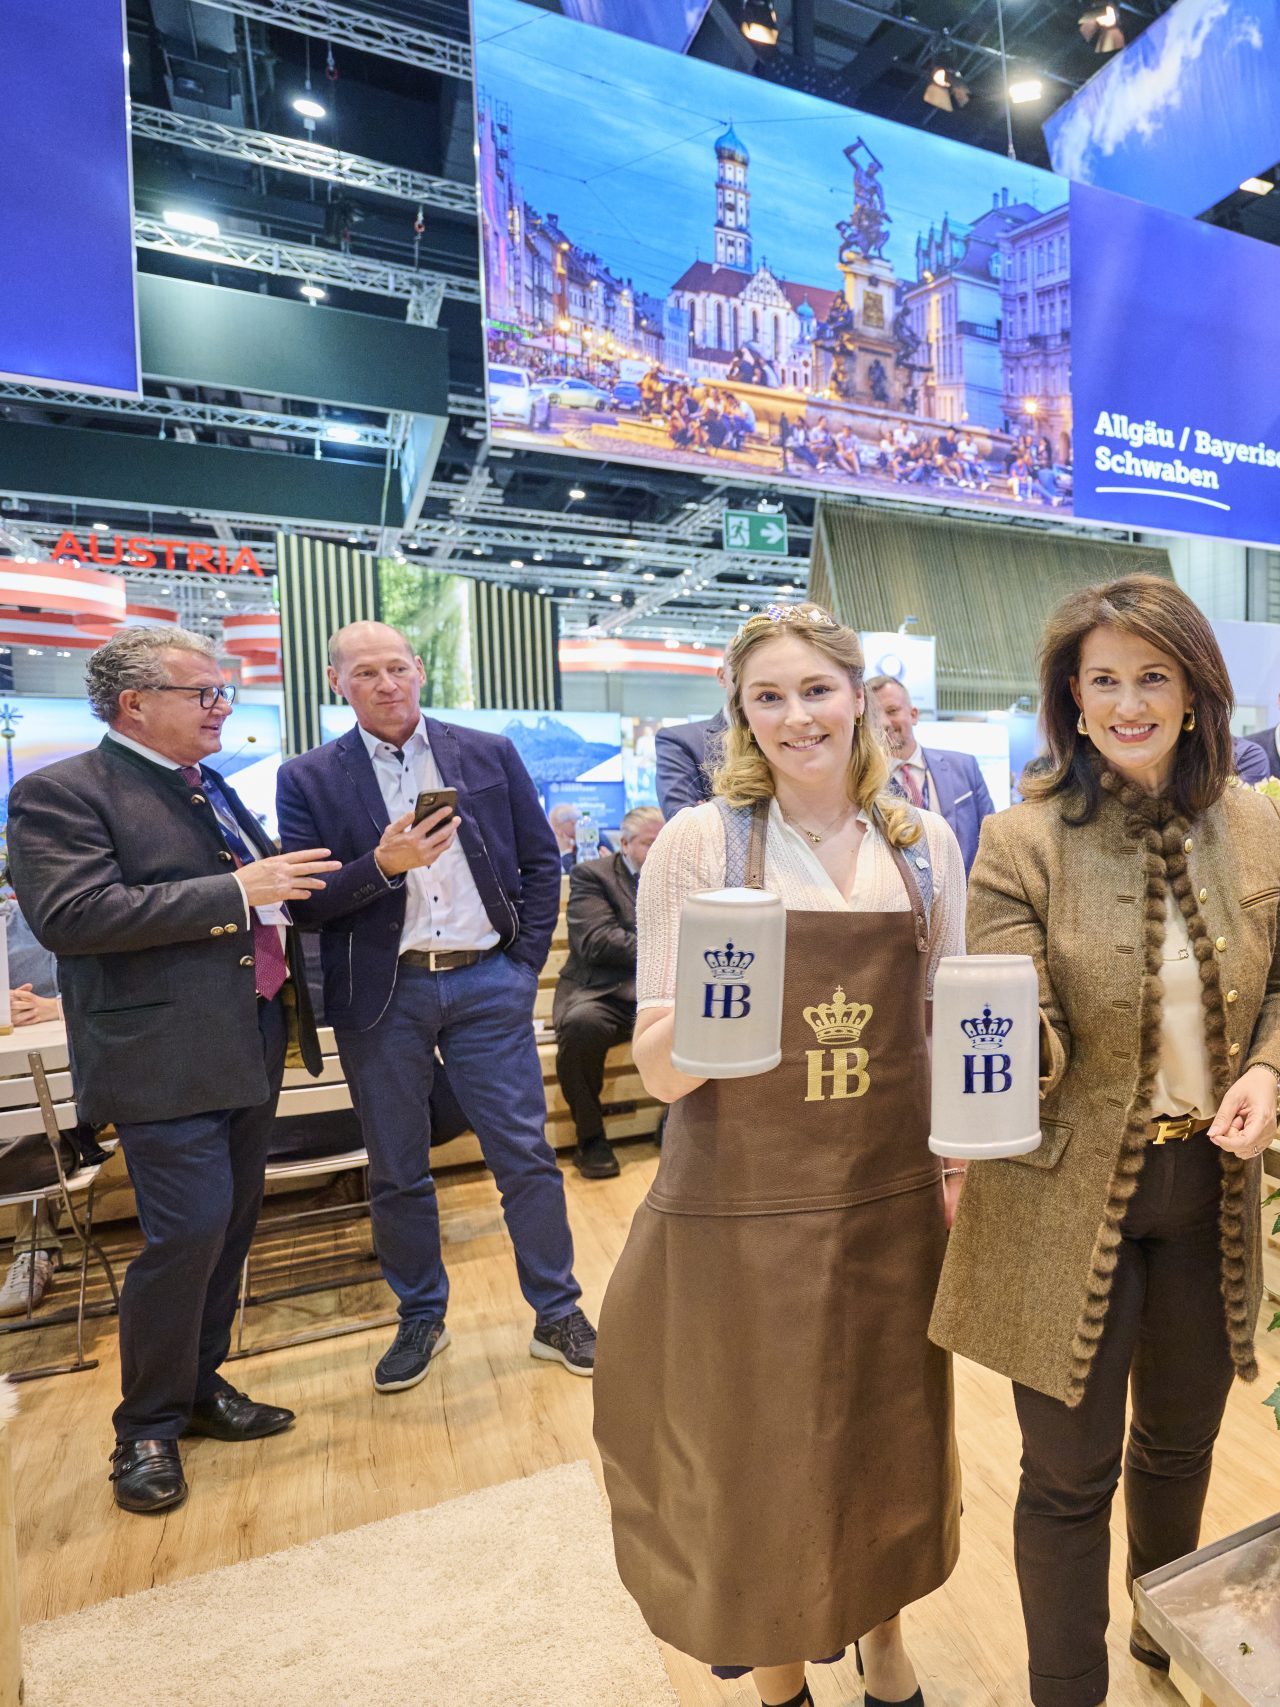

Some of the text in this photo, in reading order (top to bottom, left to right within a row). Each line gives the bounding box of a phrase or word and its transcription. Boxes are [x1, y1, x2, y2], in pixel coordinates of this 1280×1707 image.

[1094, 411, 1175, 448] Allgäu
[1179, 426, 1190, 451] /
[1095, 446, 1220, 489] Schwaben
[51, 531, 264, 577] AUSTRIA
[702, 982, 751, 1019] HB
[804, 1047, 871, 1102] HB
[962, 1053, 1013, 1094] HB
